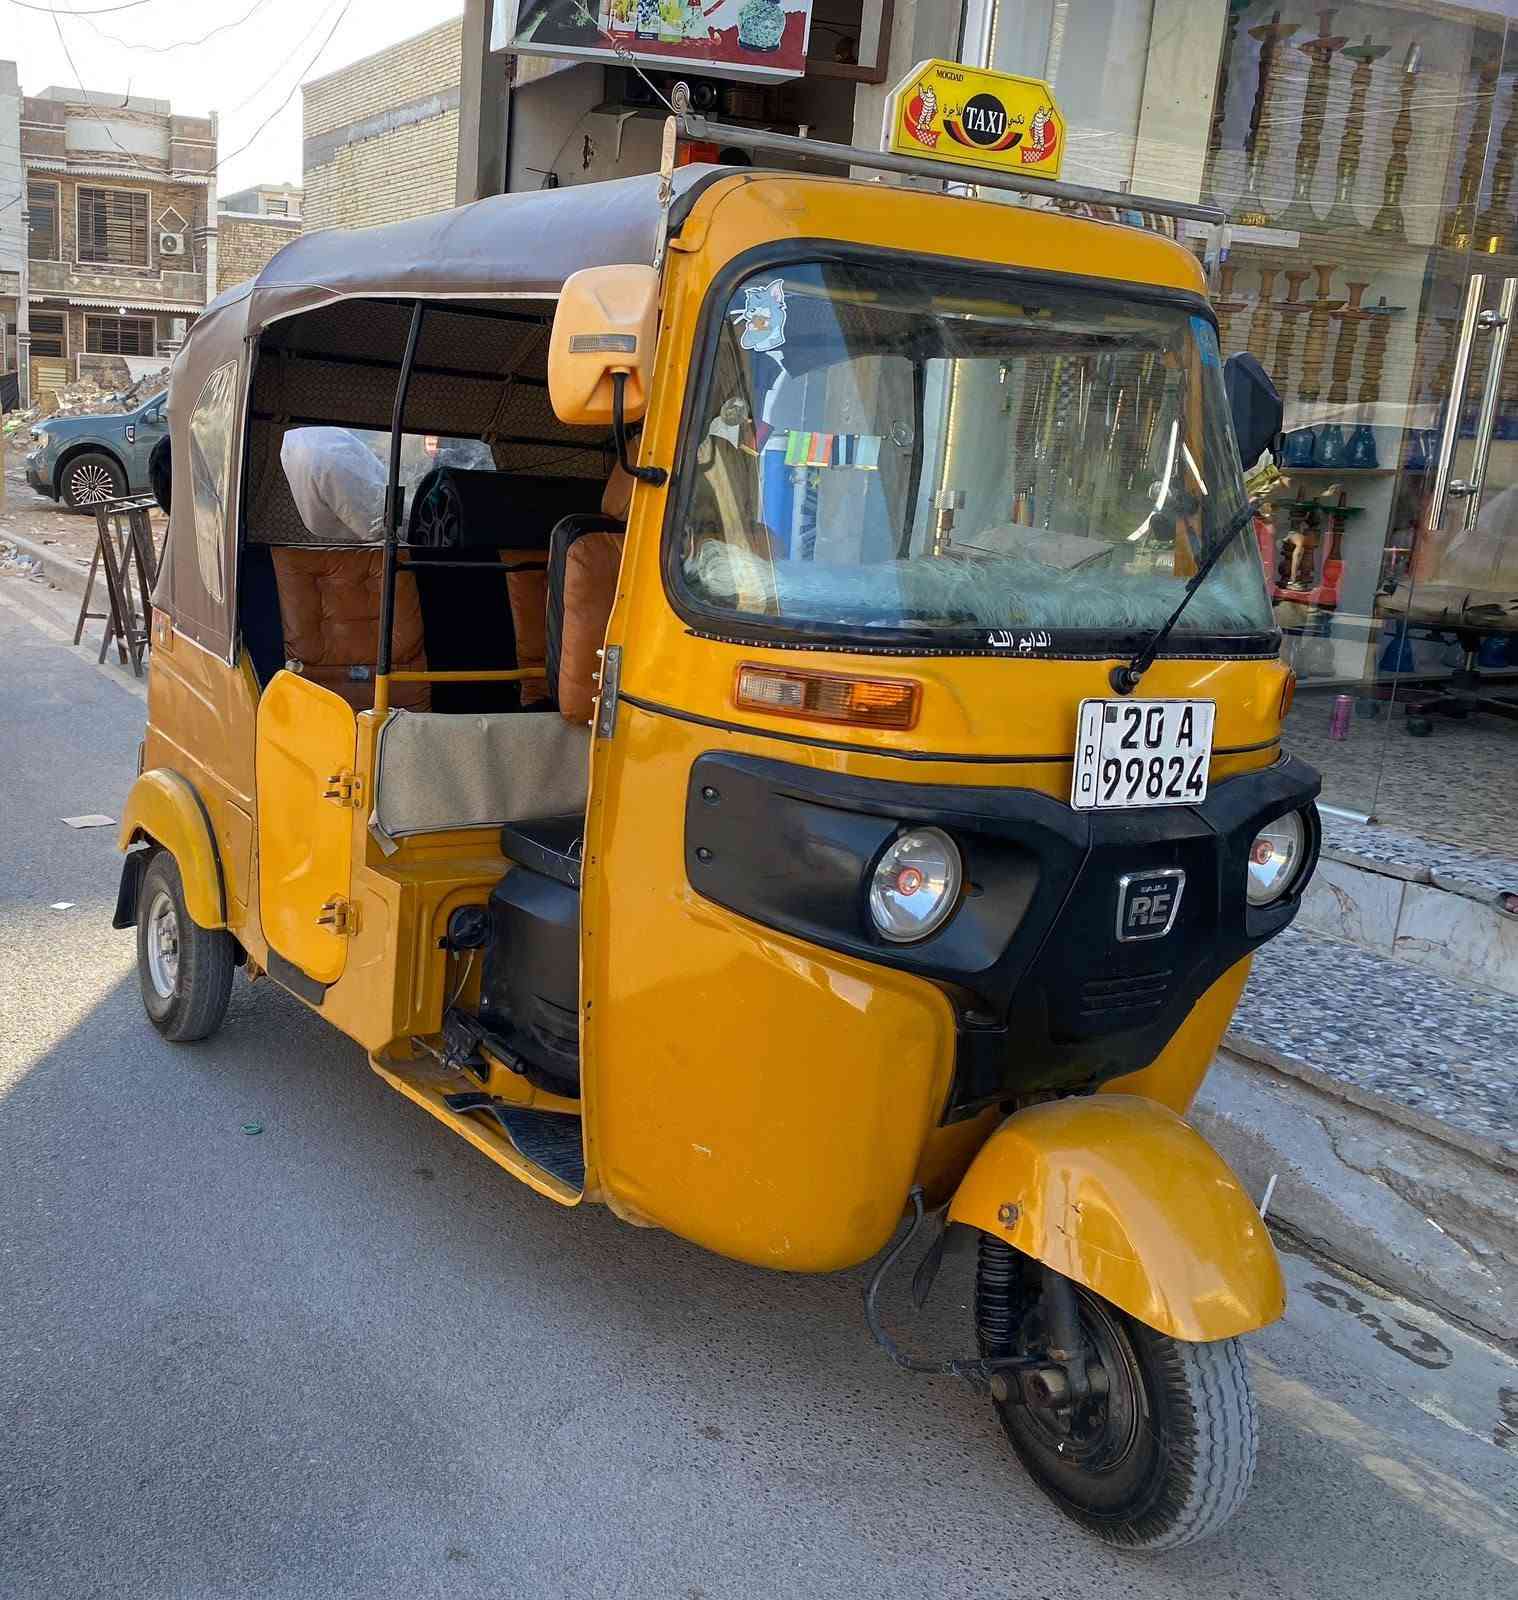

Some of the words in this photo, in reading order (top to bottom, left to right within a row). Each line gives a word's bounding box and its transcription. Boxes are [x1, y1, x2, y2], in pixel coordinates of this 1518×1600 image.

[966, 106, 1005, 135] TAXI
[988, 630, 1014, 648] الله
[1120, 706, 1165, 749] 20
[1176, 706, 1193, 748] A
[1103, 756, 1204, 801] 99824
[1128, 894, 1171, 926] RE
